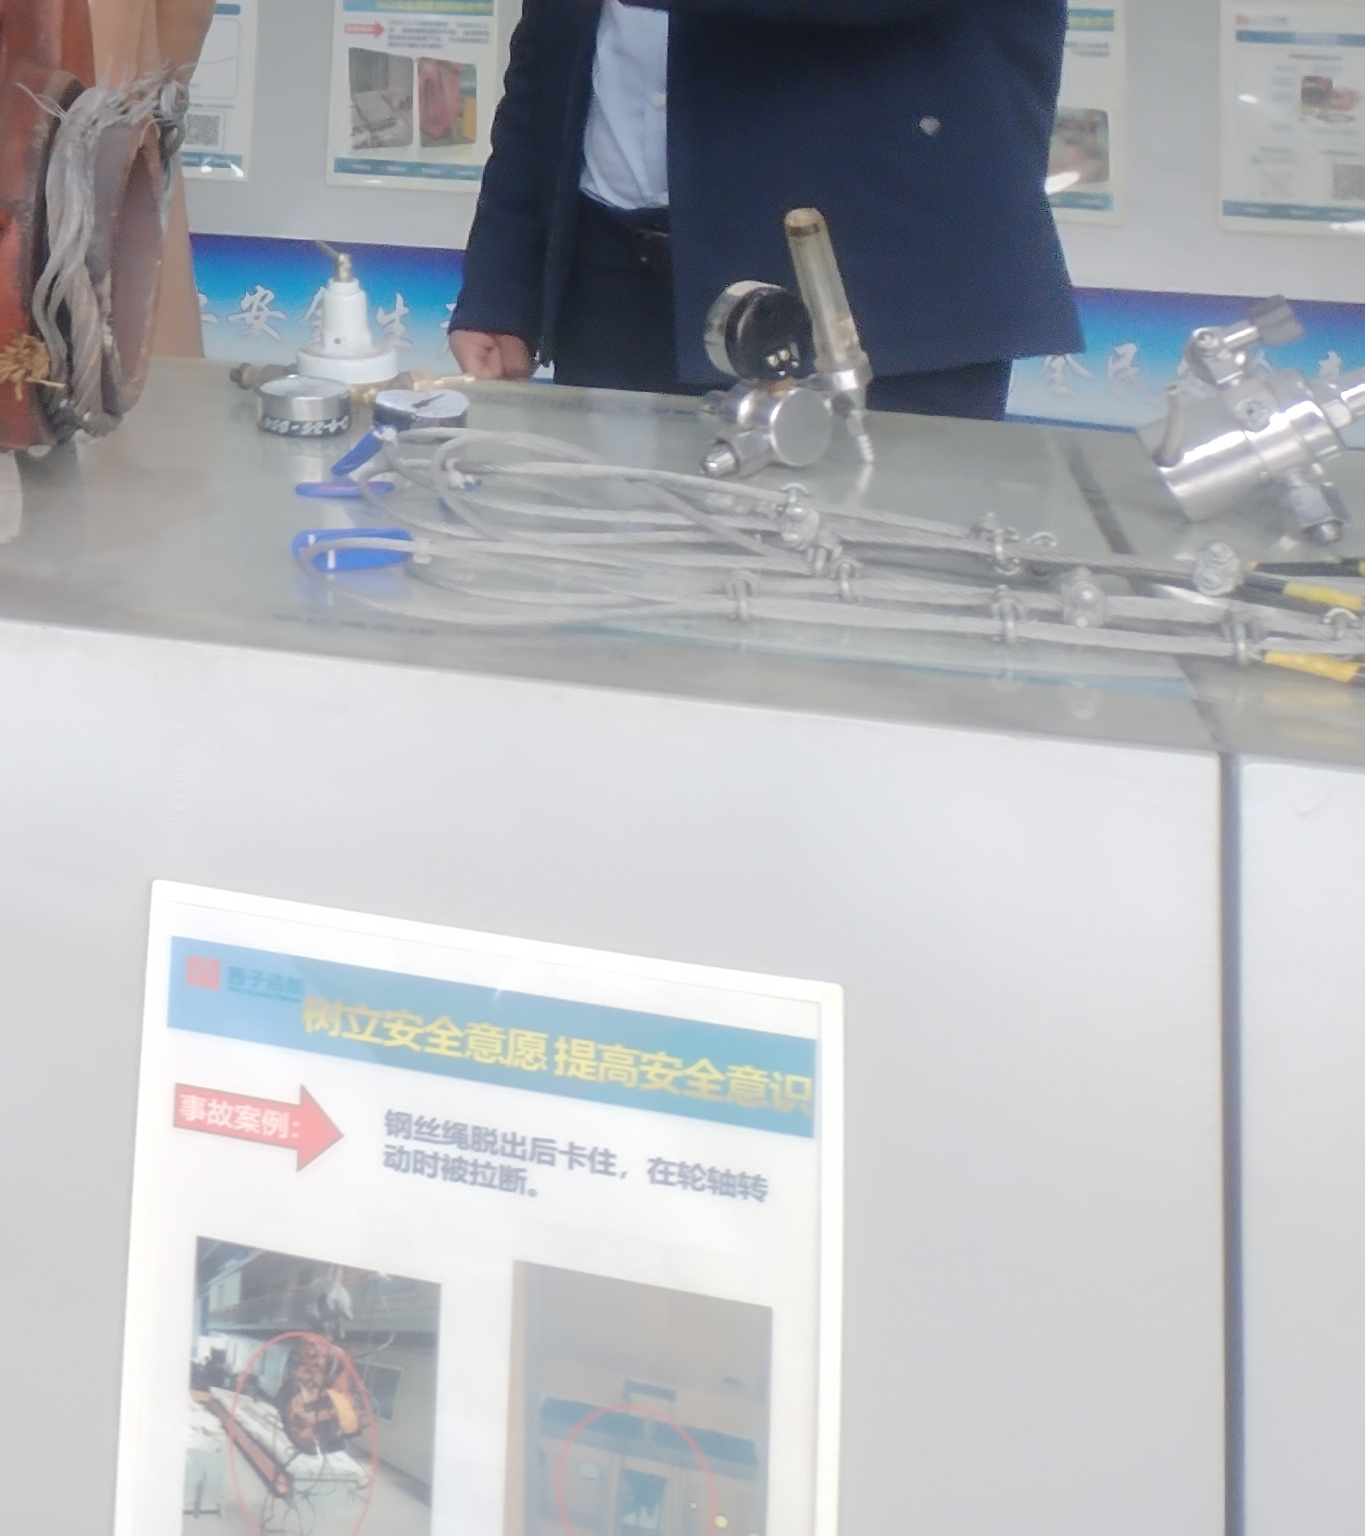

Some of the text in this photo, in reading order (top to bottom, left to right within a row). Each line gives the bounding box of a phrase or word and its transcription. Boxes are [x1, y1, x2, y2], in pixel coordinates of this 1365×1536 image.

[302, 994, 815, 1120] 树立安全意愿 提高安全意识
